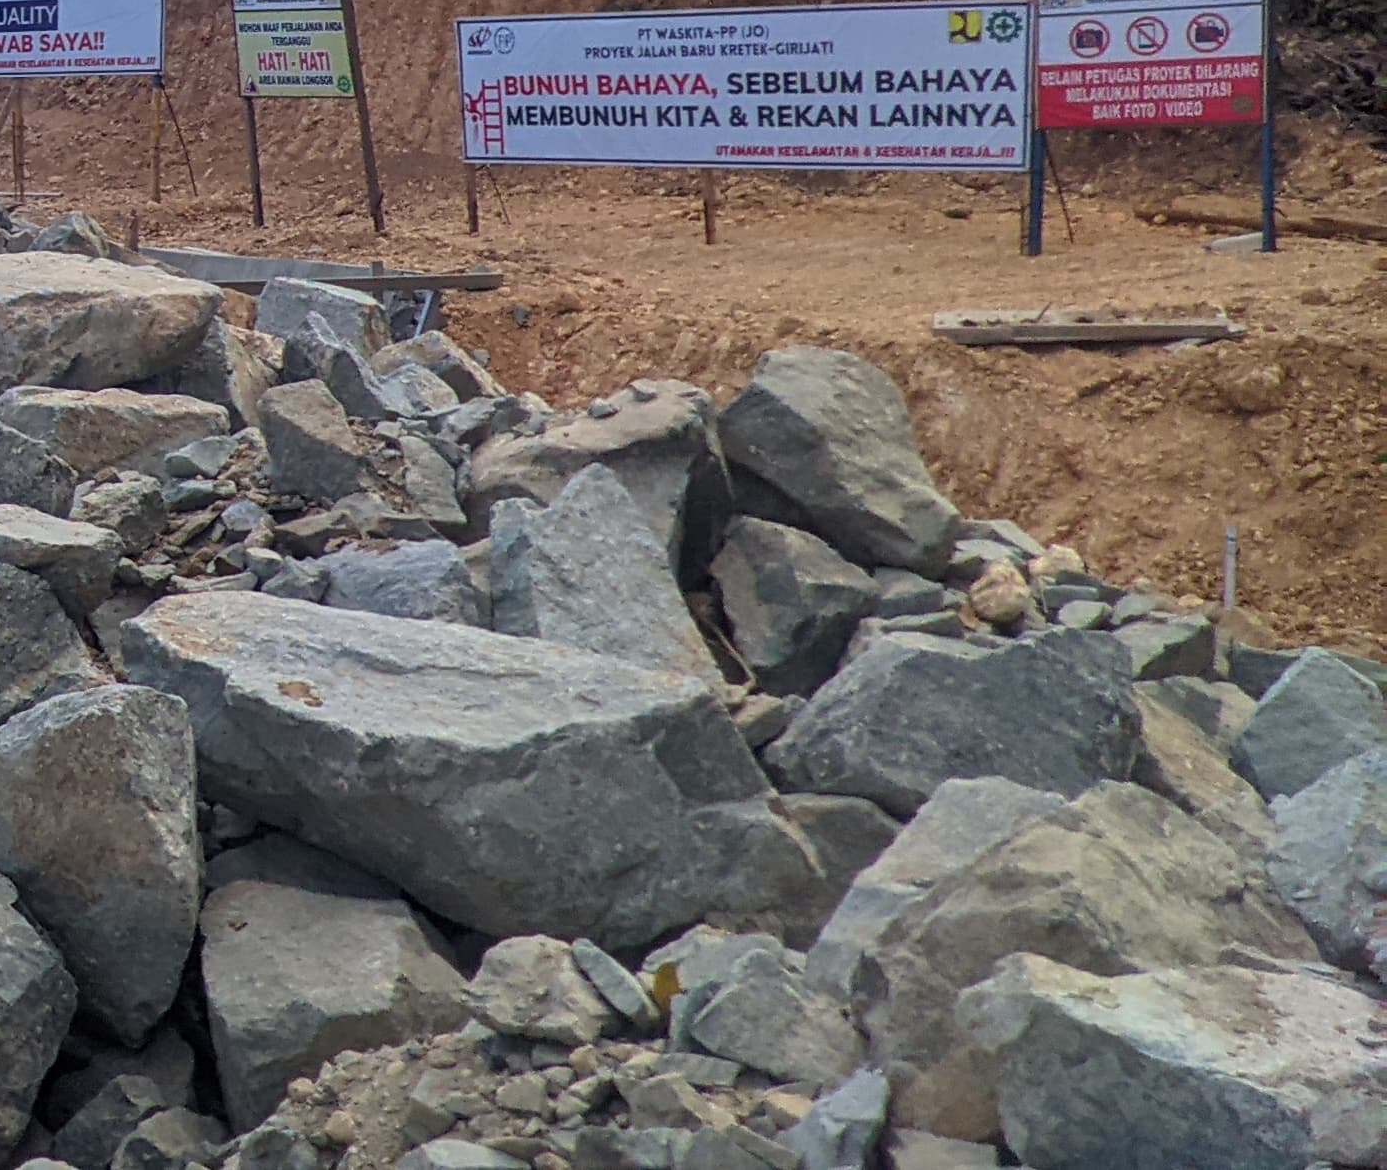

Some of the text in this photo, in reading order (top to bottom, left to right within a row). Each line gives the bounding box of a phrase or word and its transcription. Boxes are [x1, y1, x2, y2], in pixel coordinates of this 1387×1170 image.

[239, 22, 342, 32] MOHON MAAF PERJALANAN ANDA
[637, 29, 651, 40] PT
[741, 26, 769, 39] (JO)
[40, 32, 105, 51] SAYA!!
[271, 36, 311, 46] TERGANGGU
[585, 41, 834, 59] PROYEK JALAN BARU KRETEK-GIRIJATI
[258, 52, 287, 71] HATI
[299, 52, 331, 70] HATI
[259, 76, 333, 85] AREA RAWAN LONGSOR
[1042, 63, 1258, 85] SELAIN PETUGAS PROYEK DILARANG
[504, 69, 1016, 98] BUNUH BAHAYA, SEBELUM BAHAYA
[1066, 83, 1231, 102] MELAKUKAN DOKUMENTASI
[507, 102, 1016, 127] MEMBUNUH KITA & REKAN LAINNYA
[1093, 105, 1120, 119] BAIK
[1125, 103, 1155, 117] FOTO
[1166, 101, 1202, 116] VIDEO
[716, 146, 773, 157] UTAMAKAN
[778, 146, 859, 157] KESELAMATAN
[863, 146, 872, 157] &
[876, 146, 946, 158] KESEHATAN
